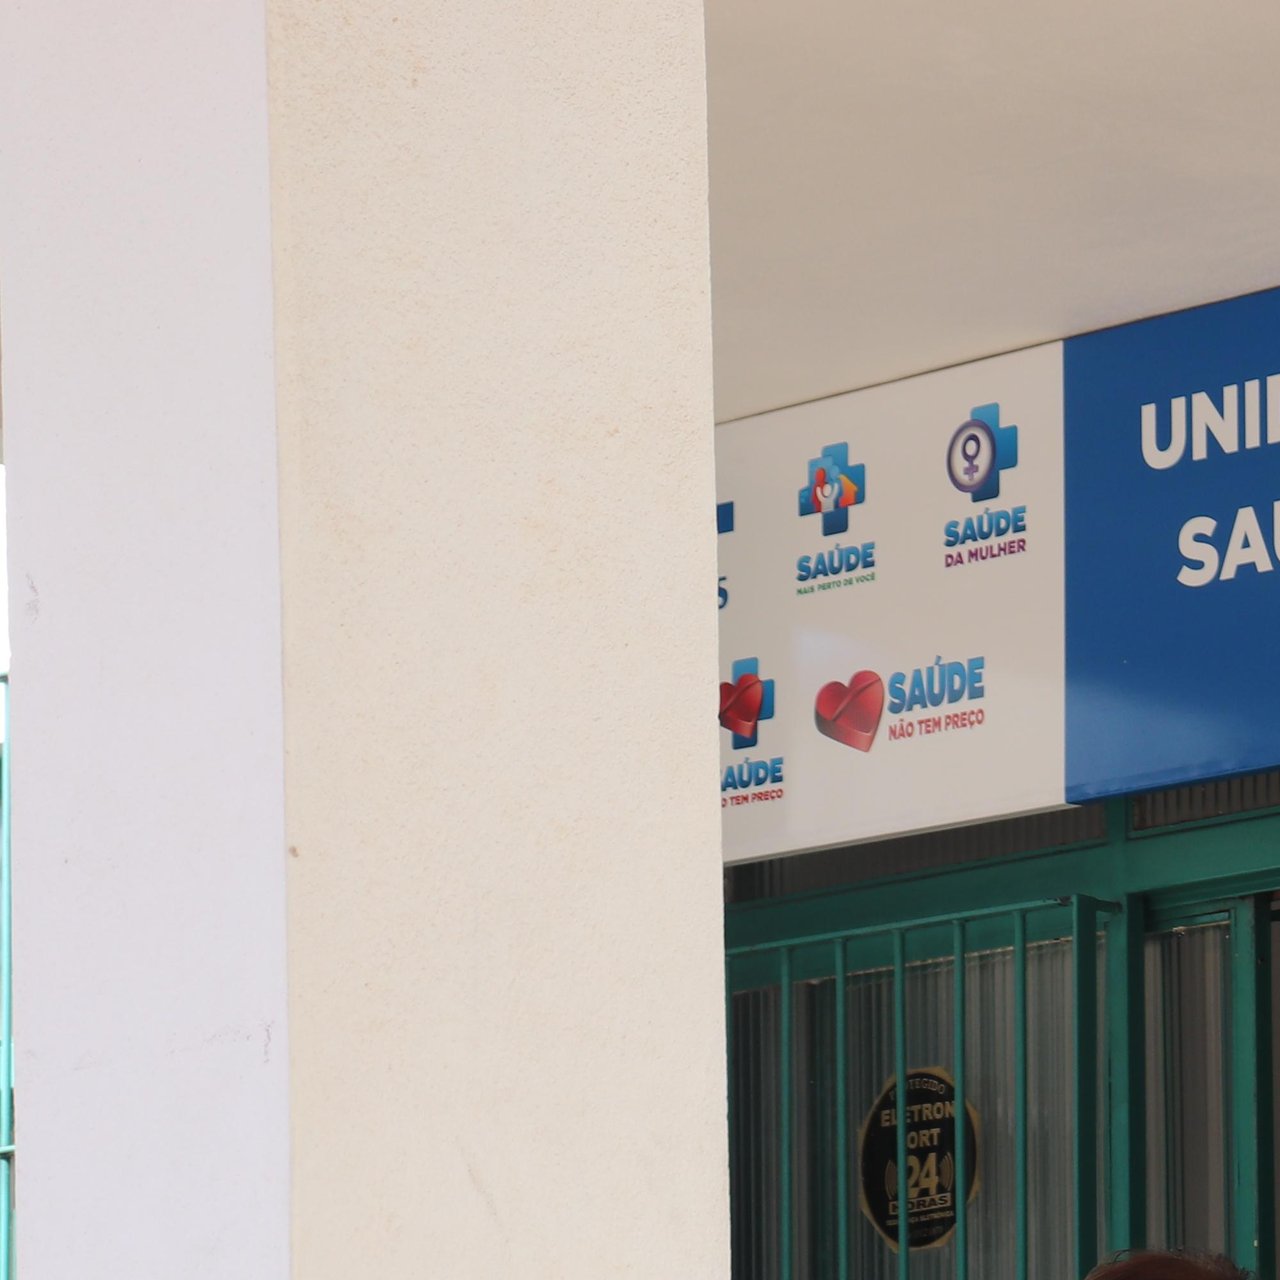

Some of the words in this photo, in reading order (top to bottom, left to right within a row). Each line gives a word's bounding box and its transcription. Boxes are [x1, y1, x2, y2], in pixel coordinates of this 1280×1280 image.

[944, 505, 1026, 548] SAÚDE
[796, 541, 875, 582] SAÚDE
[945, 551, 964, 568] DA
[968, 538, 1026, 563] MULHER
[797, 585, 815, 595] MAIS
[817, 580, 842, 591] PERTO
[843, 576, 853, 586] DE
[887, 654, 985, 715] SAÚDE
[888, 718, 914, 741] NÃO
[917, 716, 942, 735] TEM
[945, 708, 985, 731] PREÇO
[720, 756, 784, 792] AÚDE
[730, 794, 749, 806] TEM
[906, 1127, 941, 1150] ORT
[906, 1152, 940, 1199] 24
